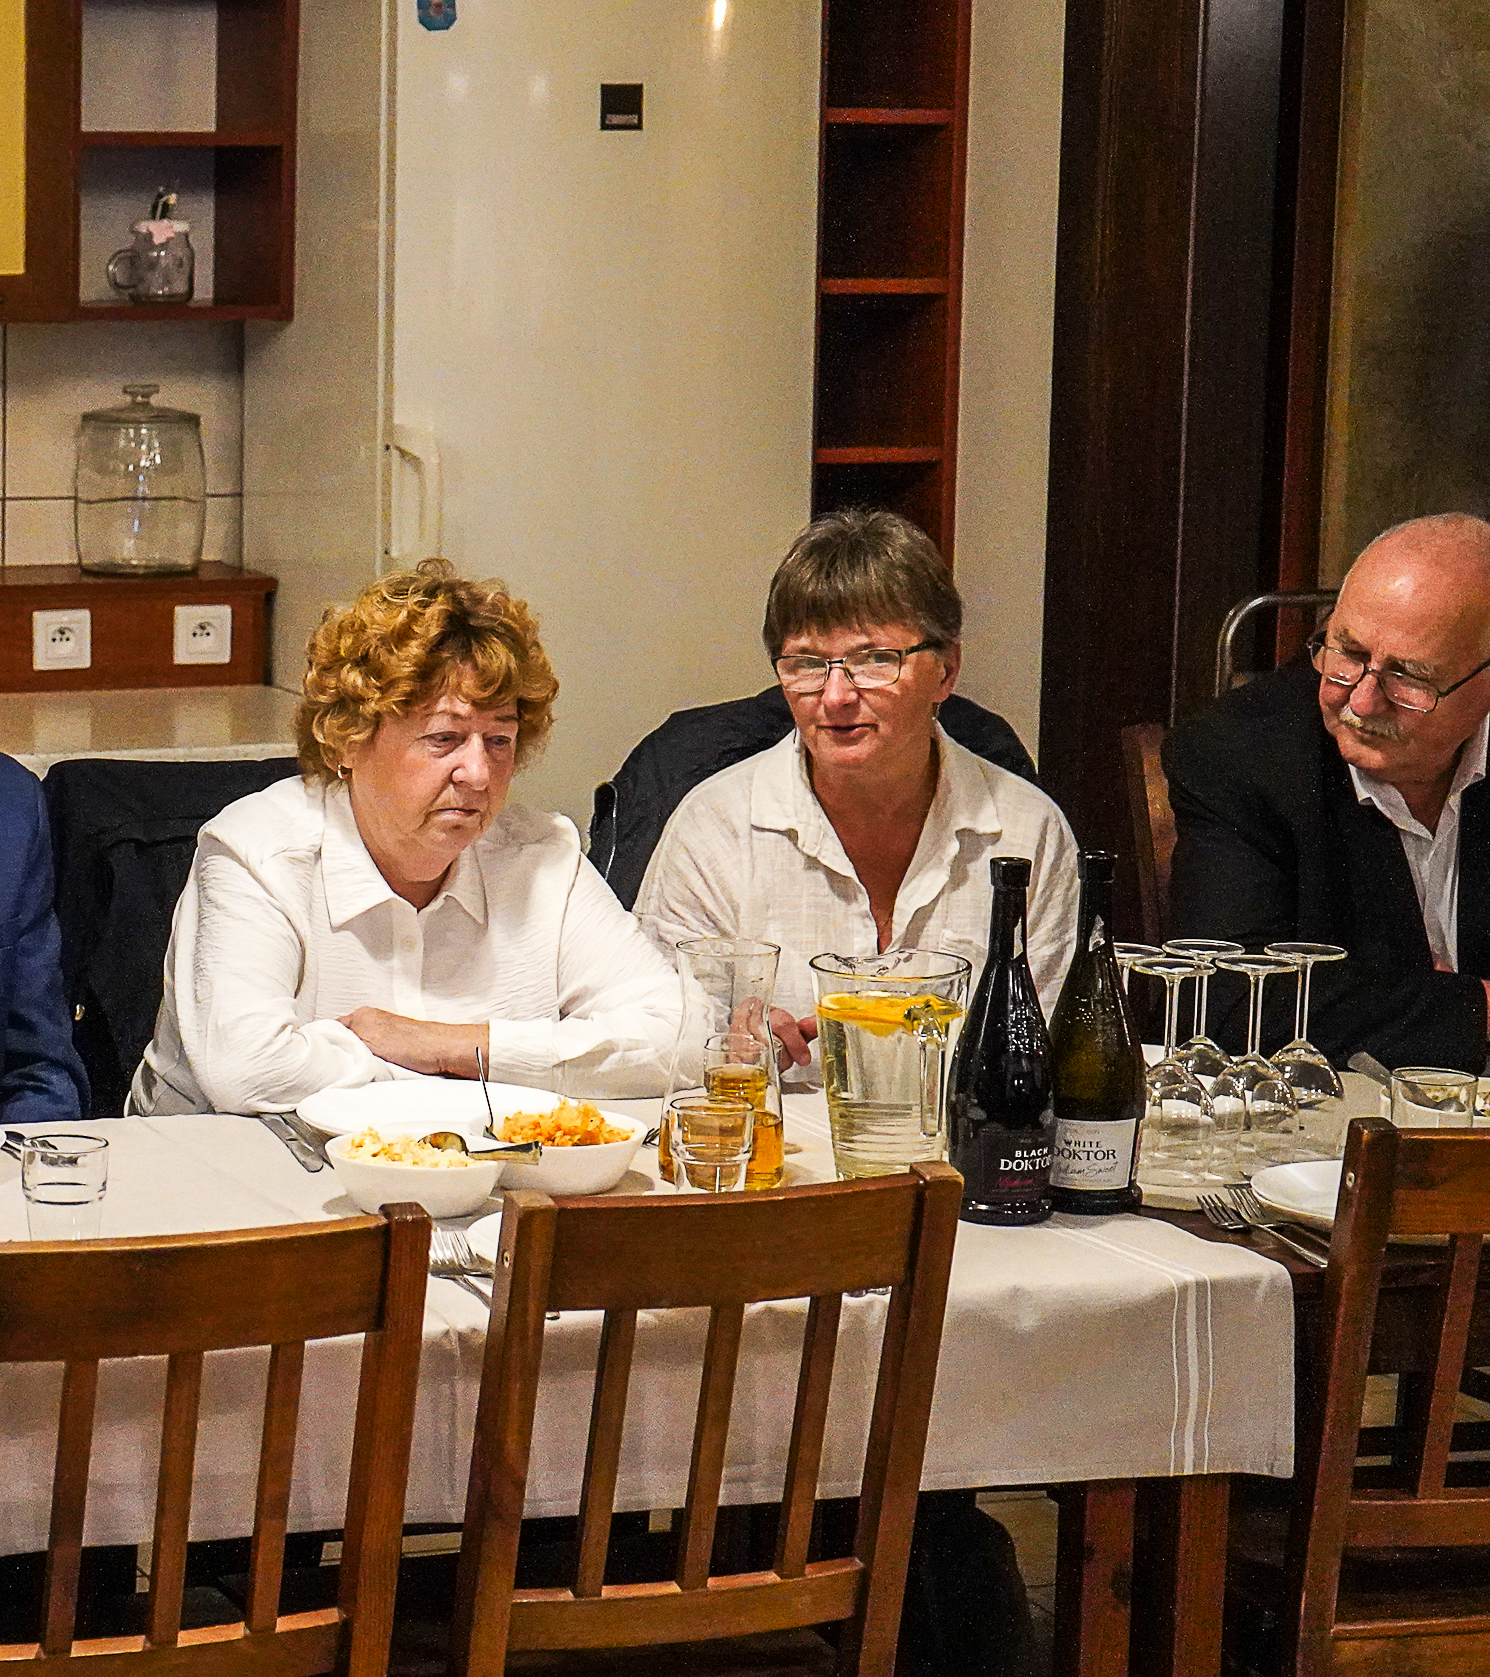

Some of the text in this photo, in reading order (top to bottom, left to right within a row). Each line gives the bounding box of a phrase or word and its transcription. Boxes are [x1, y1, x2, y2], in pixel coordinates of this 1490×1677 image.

[1064, 1139, 1102, 1148] WHITE
[1015, 1146, 1049, 1158] BLACK
[1053, 1146, 1117, 1161] DOKTOR
